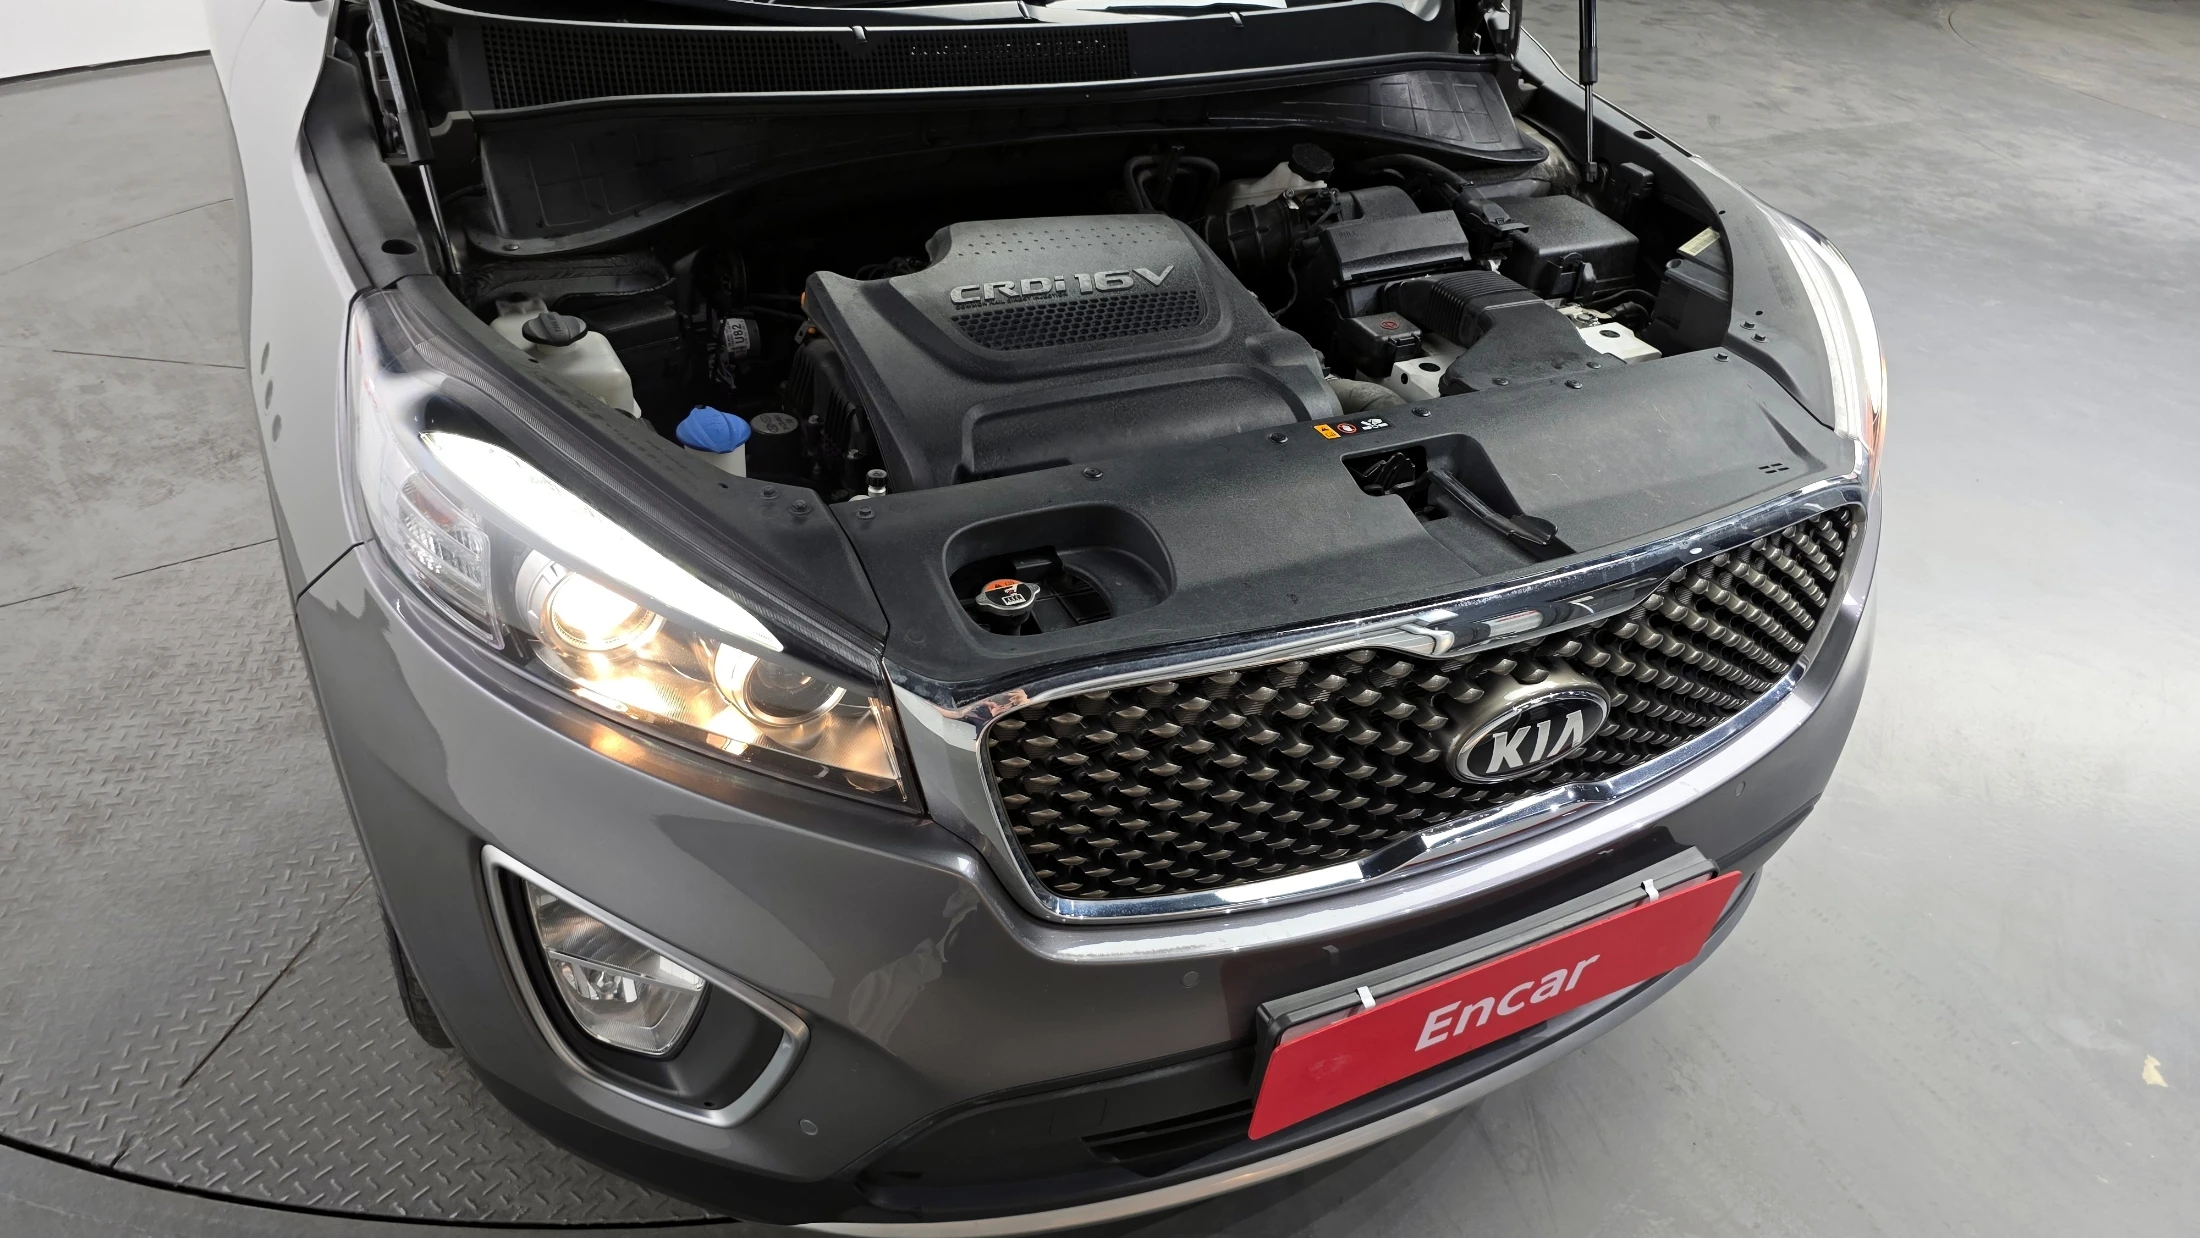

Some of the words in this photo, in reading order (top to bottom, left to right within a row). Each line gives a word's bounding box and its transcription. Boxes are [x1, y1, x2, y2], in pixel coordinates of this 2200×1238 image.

[732, 324, 744, 344] U82
[1486, 710, 1584, 773] KIA
[1414, 954, 1601, 1052] Encar
